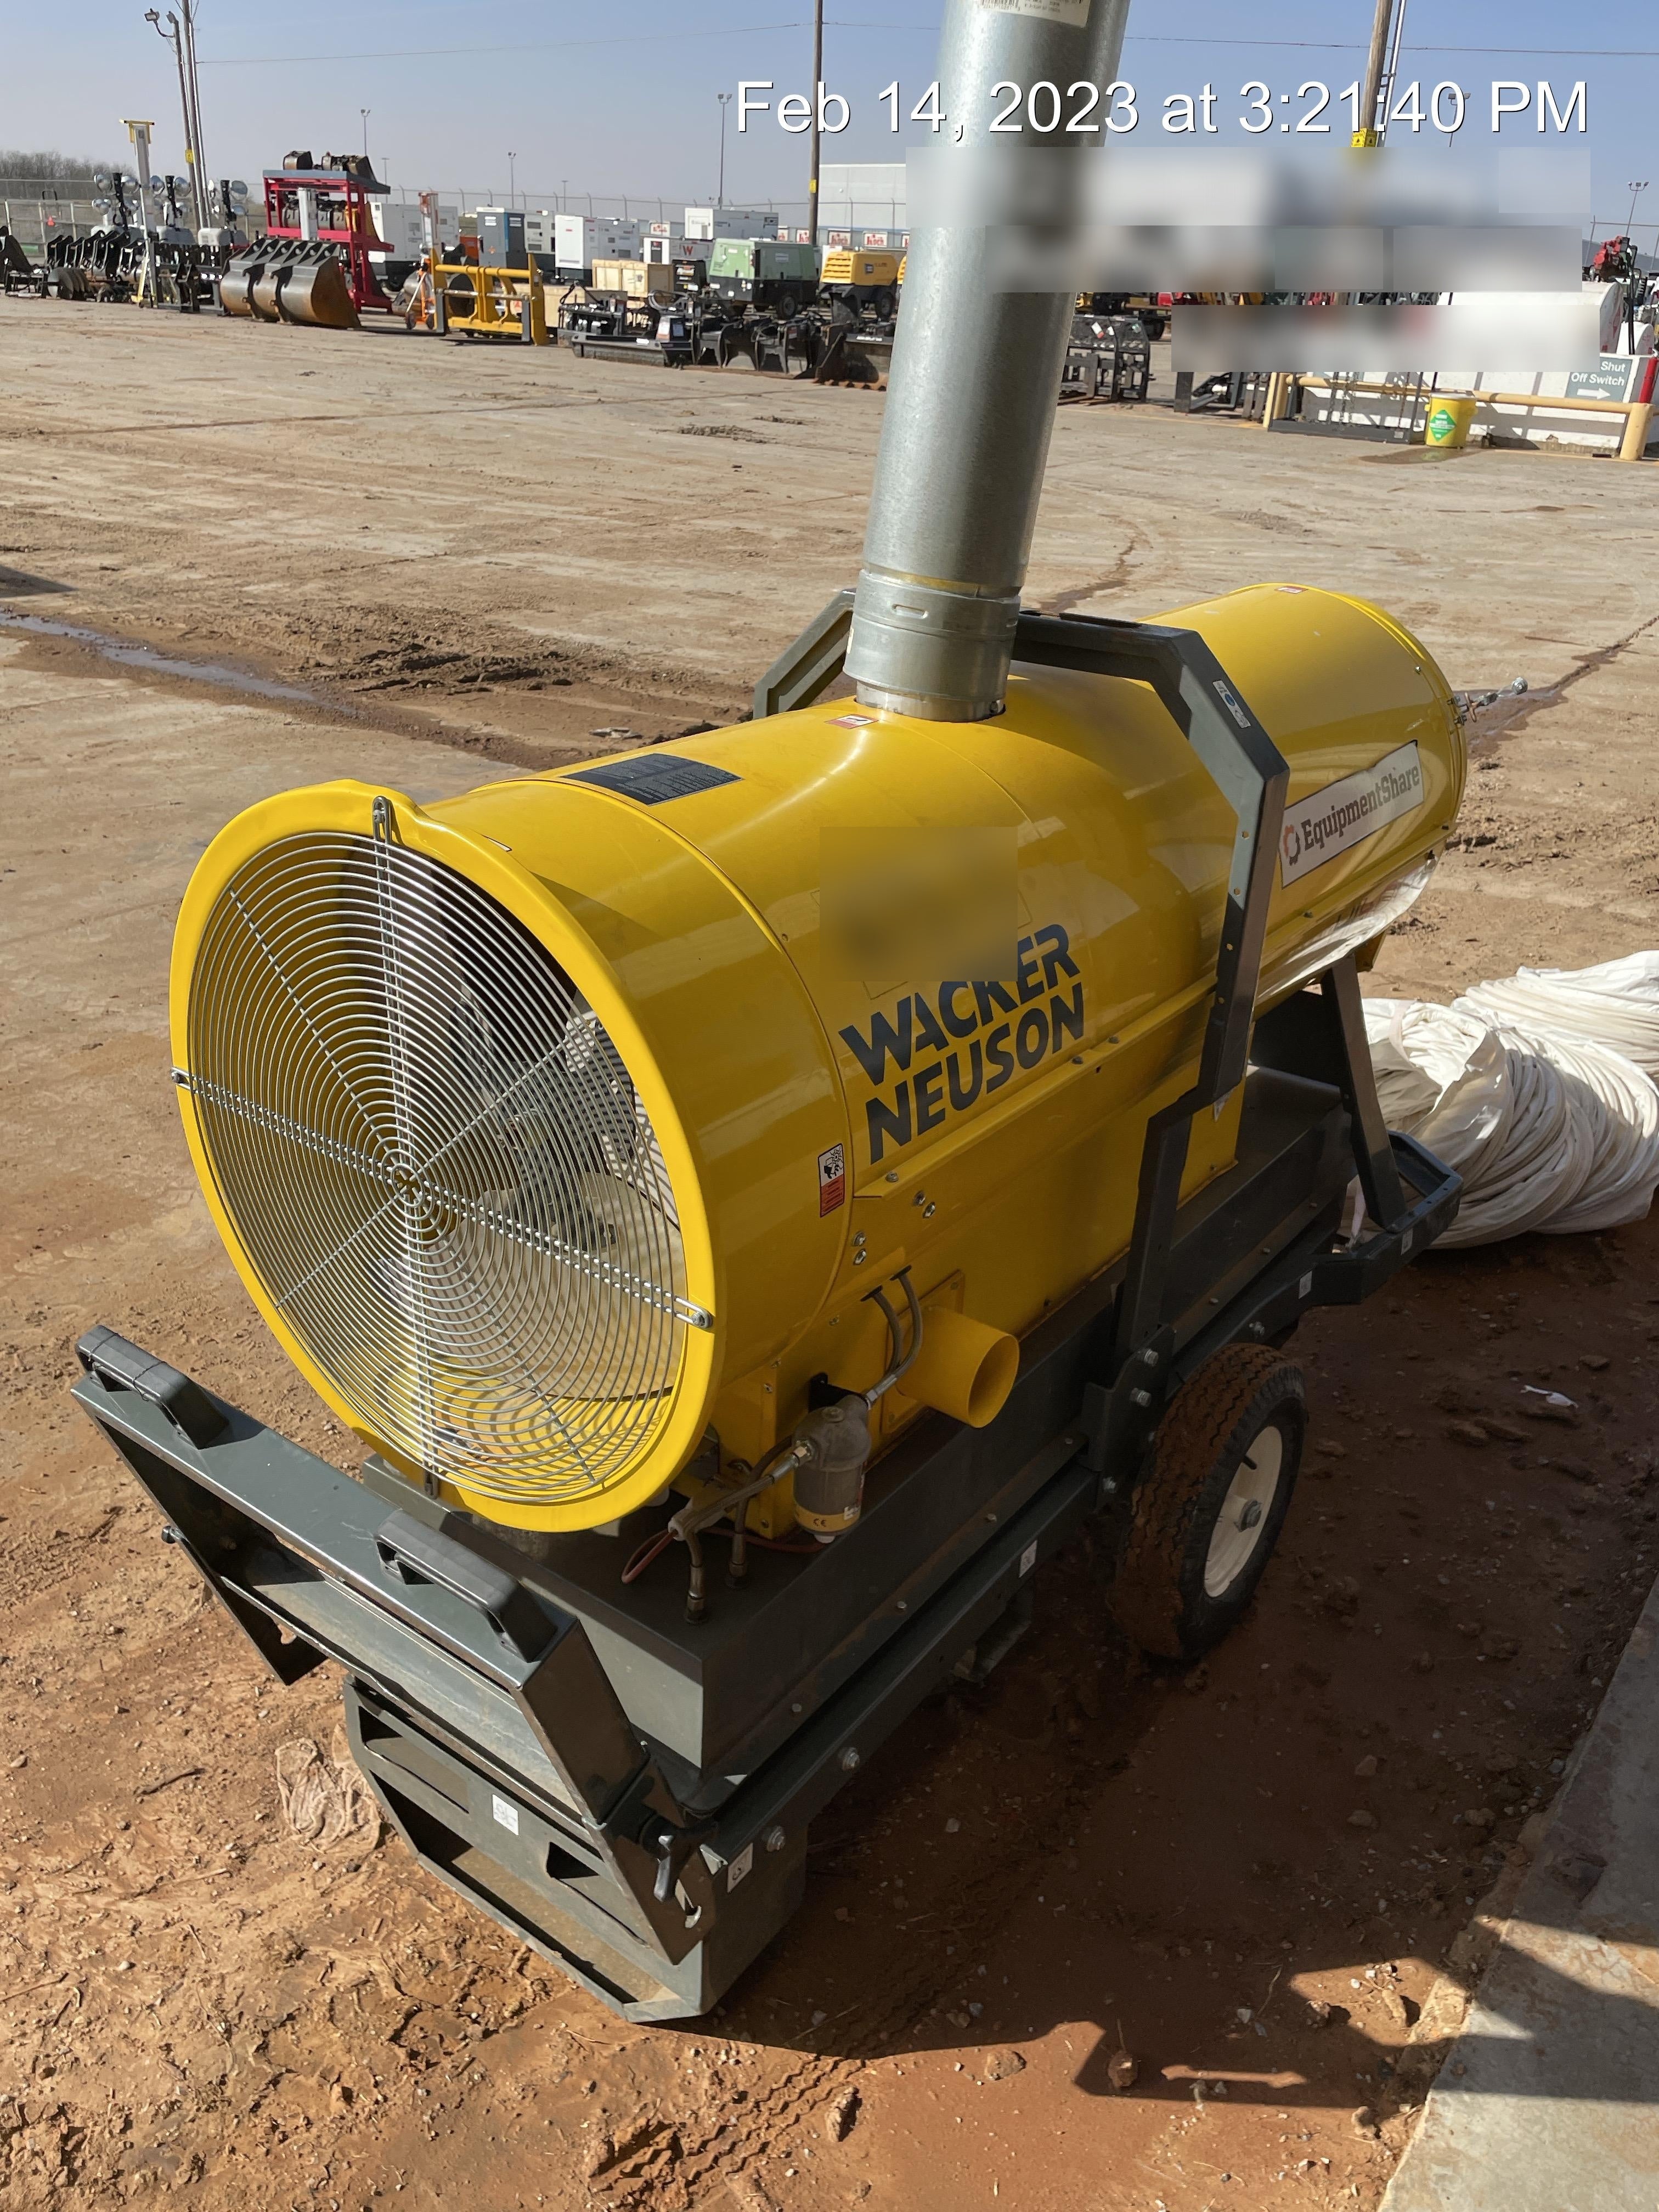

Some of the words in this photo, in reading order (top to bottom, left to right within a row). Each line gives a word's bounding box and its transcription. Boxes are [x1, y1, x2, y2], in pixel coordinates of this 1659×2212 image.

[1571, 373, 1588, 383] Off
[1589, 374, 1625, 386] Switch
[1600, 361, 1626, 373] Shut
[1300, 765, 1420, 851] EquipmentShare
[838, 924, 1081, 1086] WACKER
[865, 982, 1084, 1165] NEUSON
